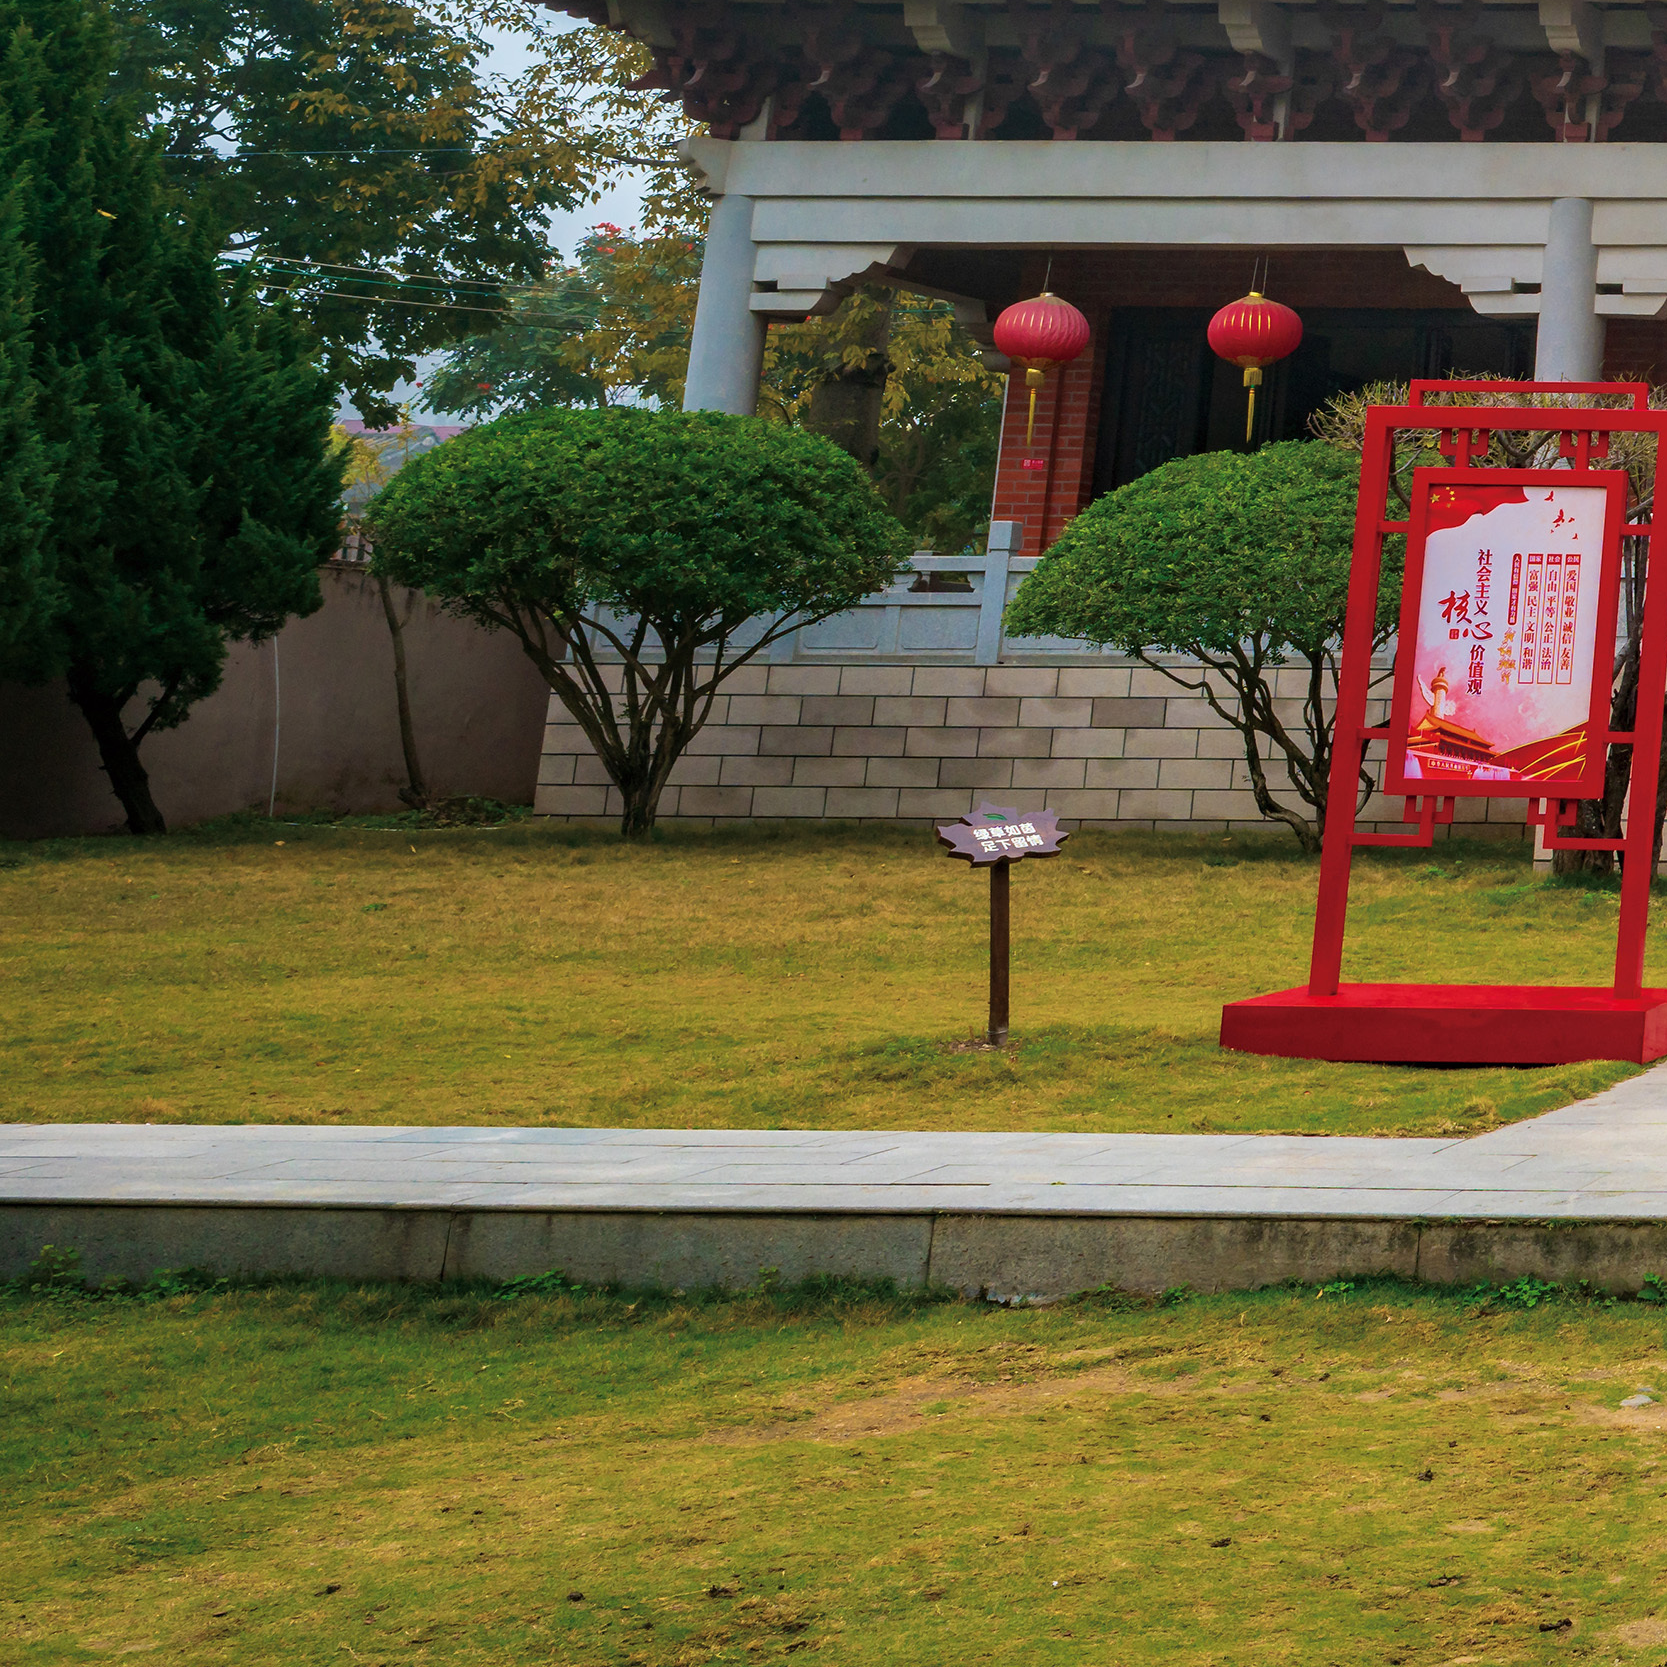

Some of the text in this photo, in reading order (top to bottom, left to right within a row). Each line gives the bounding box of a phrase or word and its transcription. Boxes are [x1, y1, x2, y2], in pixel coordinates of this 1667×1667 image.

[1474, 548, 1493, 617] 社会主义
[1547, 555, 1560, 563] 社会
[1566, 555, 1579, 563] 公民
[1522, 569, 1539, 670] 富强 民主 文明 和谐
[1541, 569, 1558, 670] 自由 平等 公正 法治
[1560, 570, 1577, 671] 爱国 敬业 诚信 友善
[1466, 644, 1486, 695] 价值观
[973, 822, 1036, 840] 绿草如茵
[980, 834, 1044, 853] 足下留情
